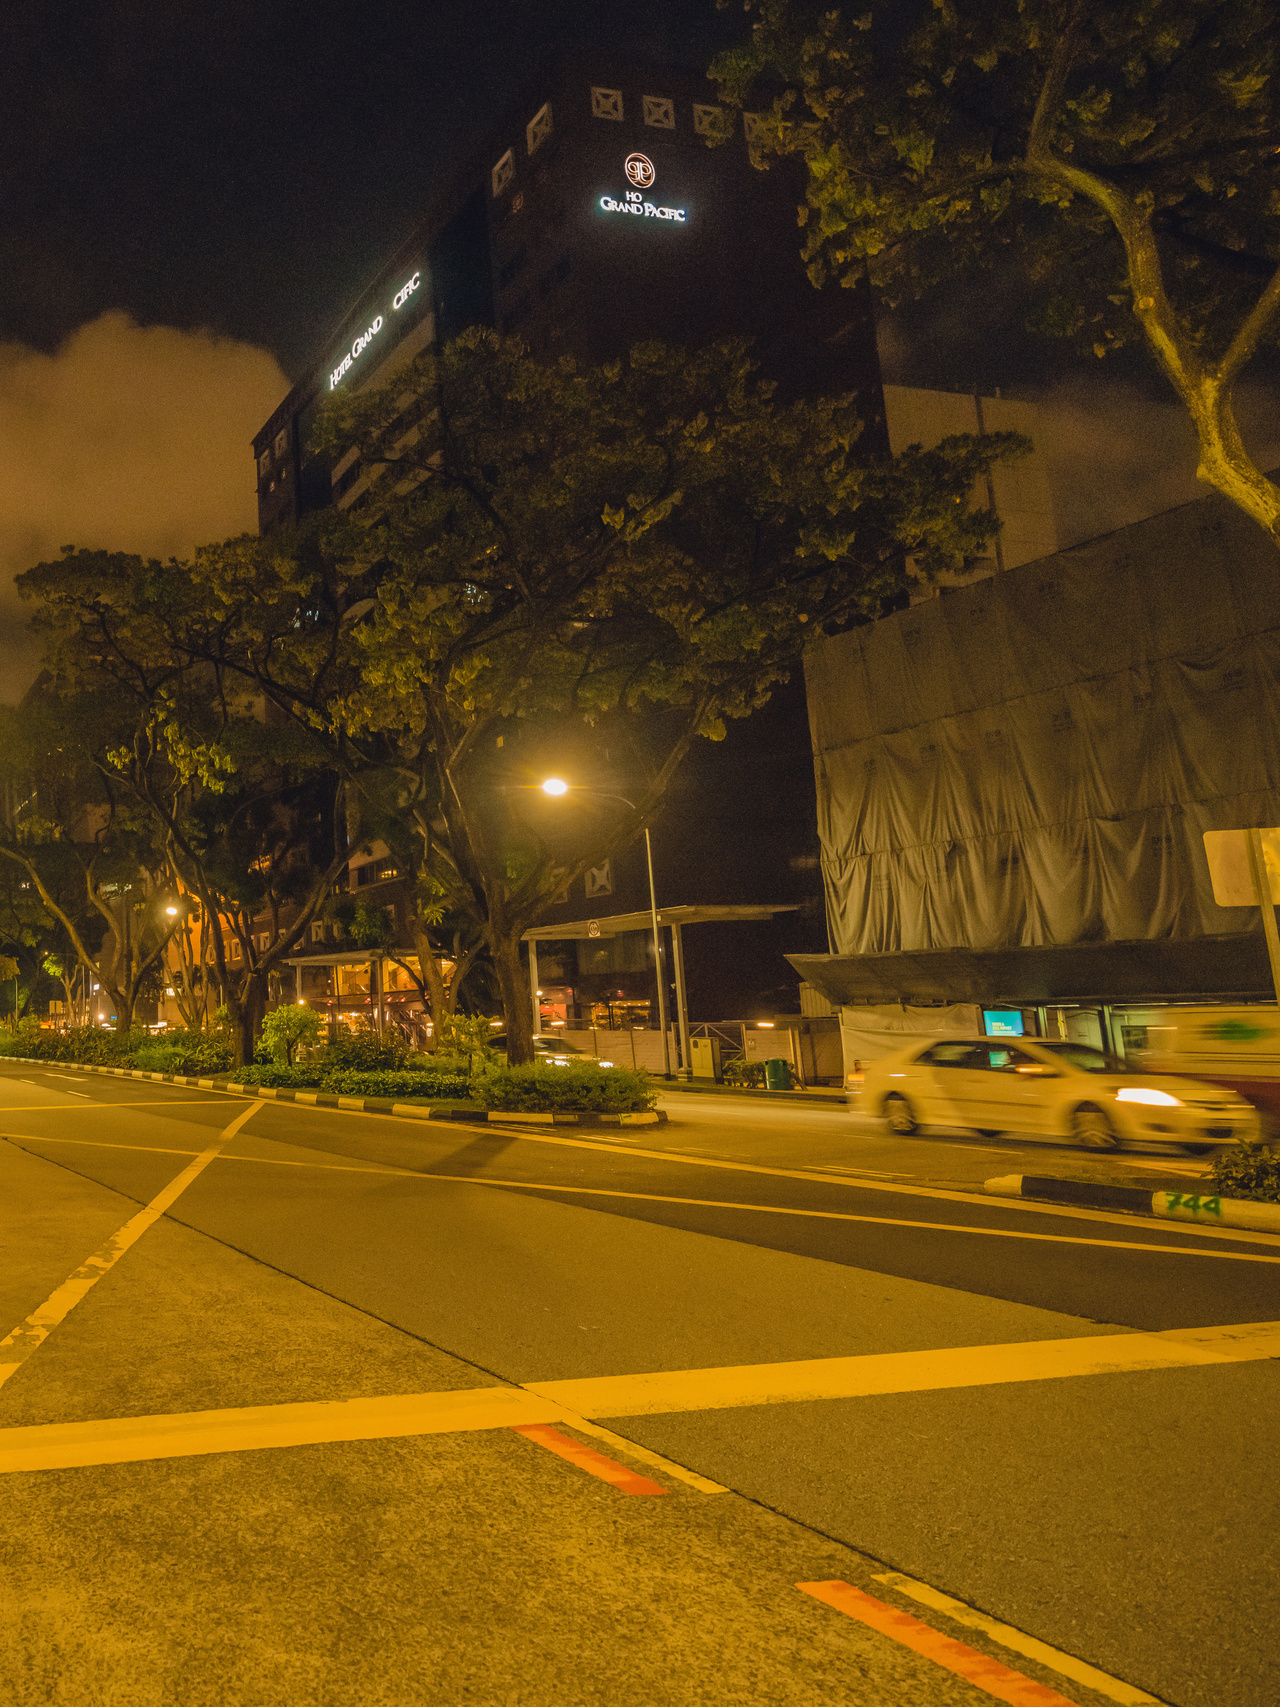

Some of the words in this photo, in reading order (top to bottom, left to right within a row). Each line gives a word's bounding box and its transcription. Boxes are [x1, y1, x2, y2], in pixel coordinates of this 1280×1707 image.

[600, 196, 643, 215] GRAND
[643, 202, 686, 222] PACIFIC
[625, 191, 642, 203] HO
[329, 352, 353, 391] HOTEL
[352, 315, 383, 358] GRAND
[393, 271, 420, 310] CIFIC
[1165, 1191, 1222, 1216] 744
